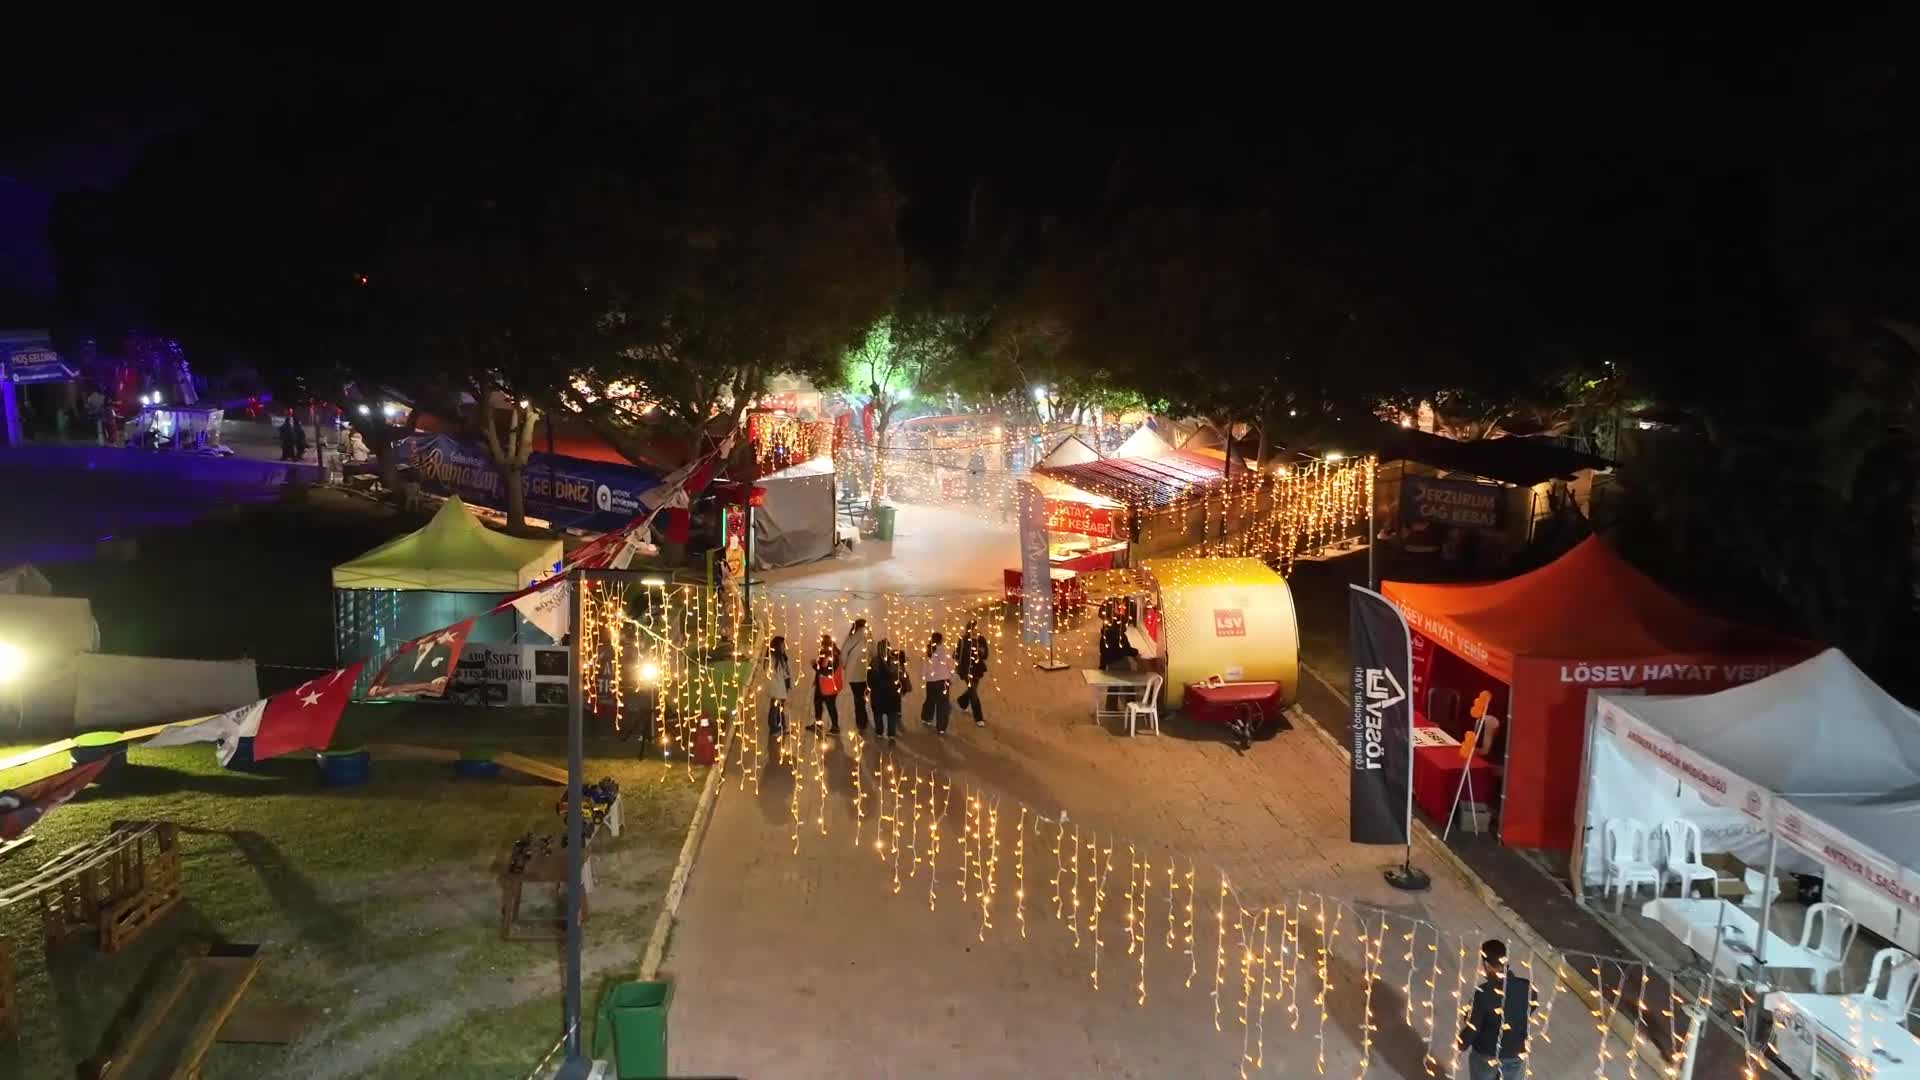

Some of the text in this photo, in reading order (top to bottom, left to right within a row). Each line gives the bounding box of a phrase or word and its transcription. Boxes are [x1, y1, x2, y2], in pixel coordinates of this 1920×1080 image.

[1424, 617, 1456, 646] HAYAT
[1560, 661, 1637, 683] LÖSEV
[1641, 664, 1718, 682] HAYAT
